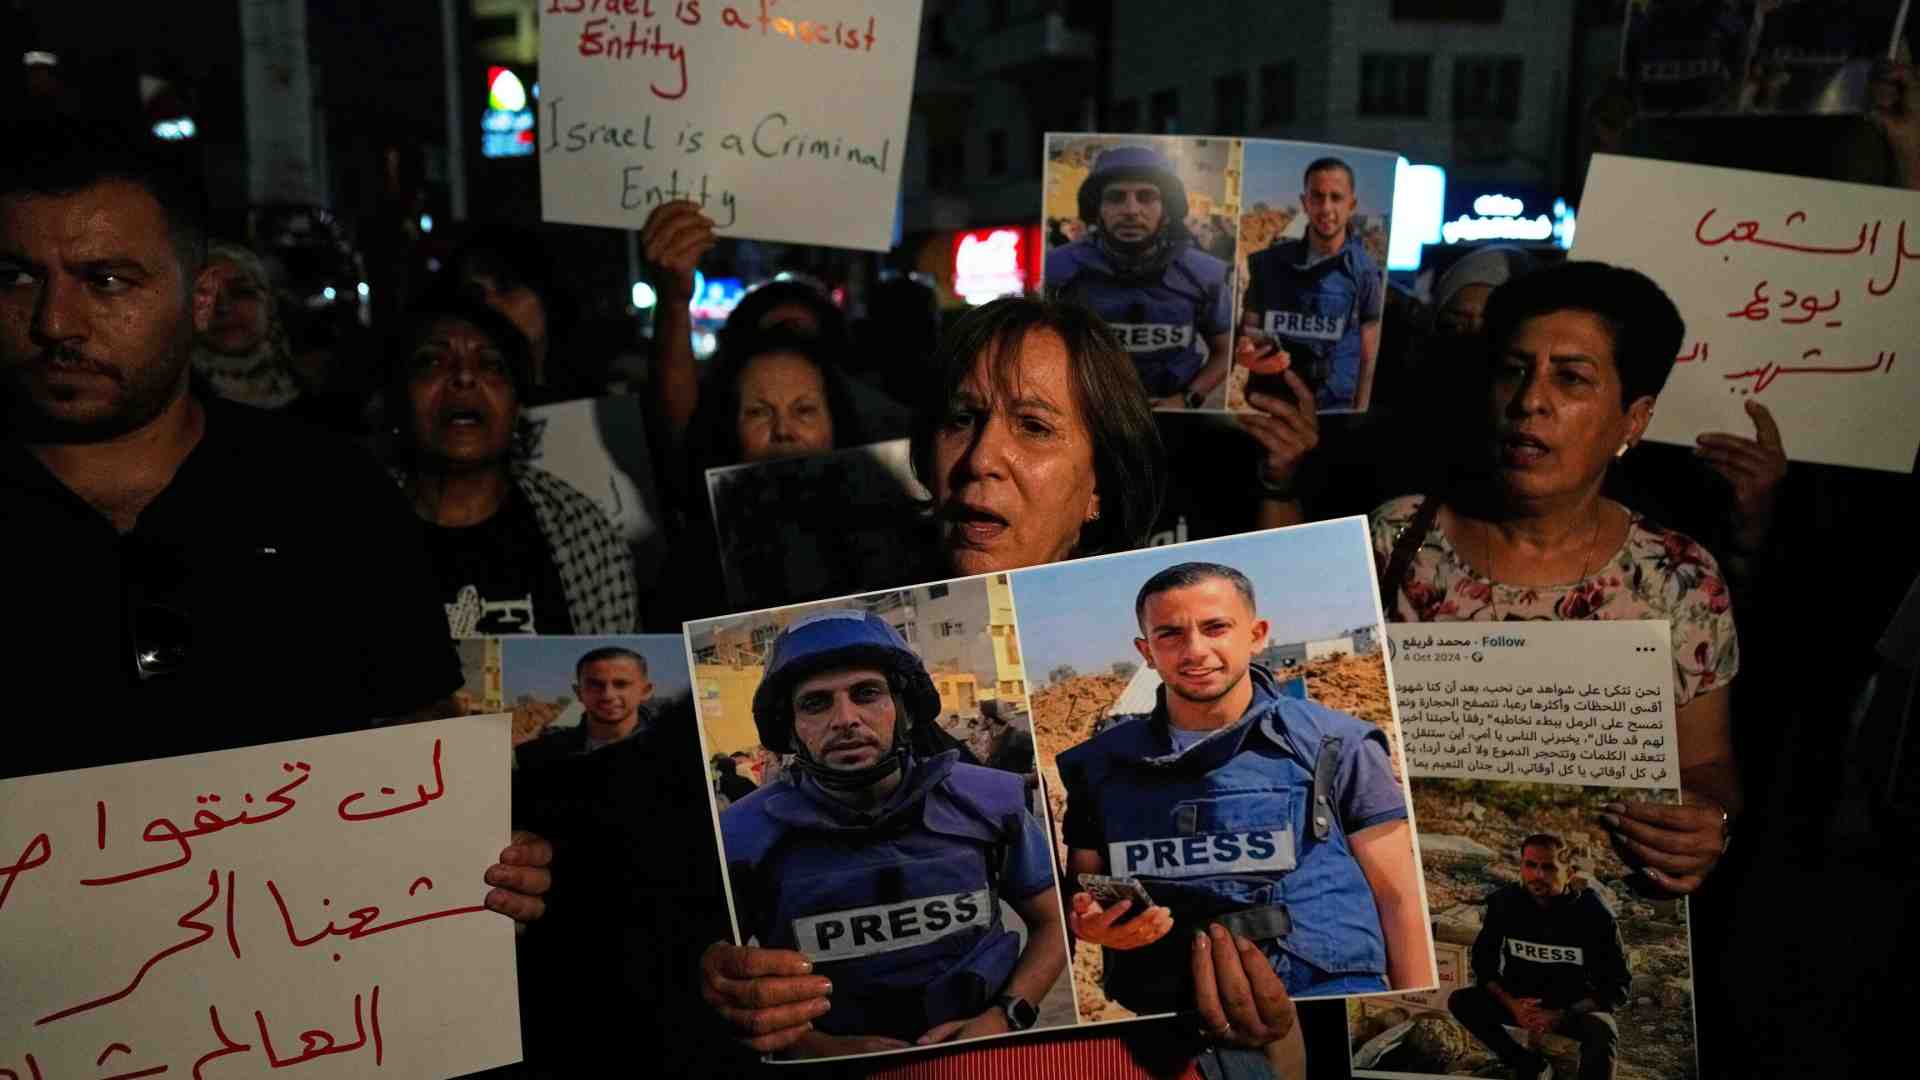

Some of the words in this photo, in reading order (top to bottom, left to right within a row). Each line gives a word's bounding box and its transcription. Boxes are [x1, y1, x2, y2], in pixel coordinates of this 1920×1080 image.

[722, 8, 751, 29] a
[758, 0, 876, 51] fascist
[579, 18, 687, 99] Entity
[546, 98, 656, 153] Israel
[676, 119, 703, 152] is
[720, 136, 745, 156] a
[752, 112, 890, 174] Criminal
[1273, 313, 1338, 333] PRESS
[1112, 328, 1183, 346] RESS
[1436, 636, 1472, 648] محمد
[1481, 635, 1526, 648] Follow
[1413, 651, 1432, 662] Oct
[1578, 684, 1601, 698] على
[1419, 696, 1460, 710] الحجارة
[1573, 699, 1626, 713] اللحظات
[1566, 715, 1597, 731] الرمل
[1601, 717, 1624, 731] على
[1506, 729, 1537, 743] الناس
[1642, 735, 1664, 749] لهم
[1492, 745, 1530, 759] الدموع
[1579, 749, 1627, 762] الكلمات
[1496, 759, 1514, 775] إلى
[1558, 764, 1575, 777] كل
[1589, 765, 1626, 779] أوقاتي
[1630, 766, 1647, 780] كل
[1649, 767, 1667, 781] في
[337, 737, 445, 822] لن
[1126, 831, 1278, 873] PRESS
[266, 876, 488, 963] شعبنا
[814, 892, 979, 951] PRESS
[34, 868, 242, 1026] الحر
[1513, 942, 1577, 961] PRESS
